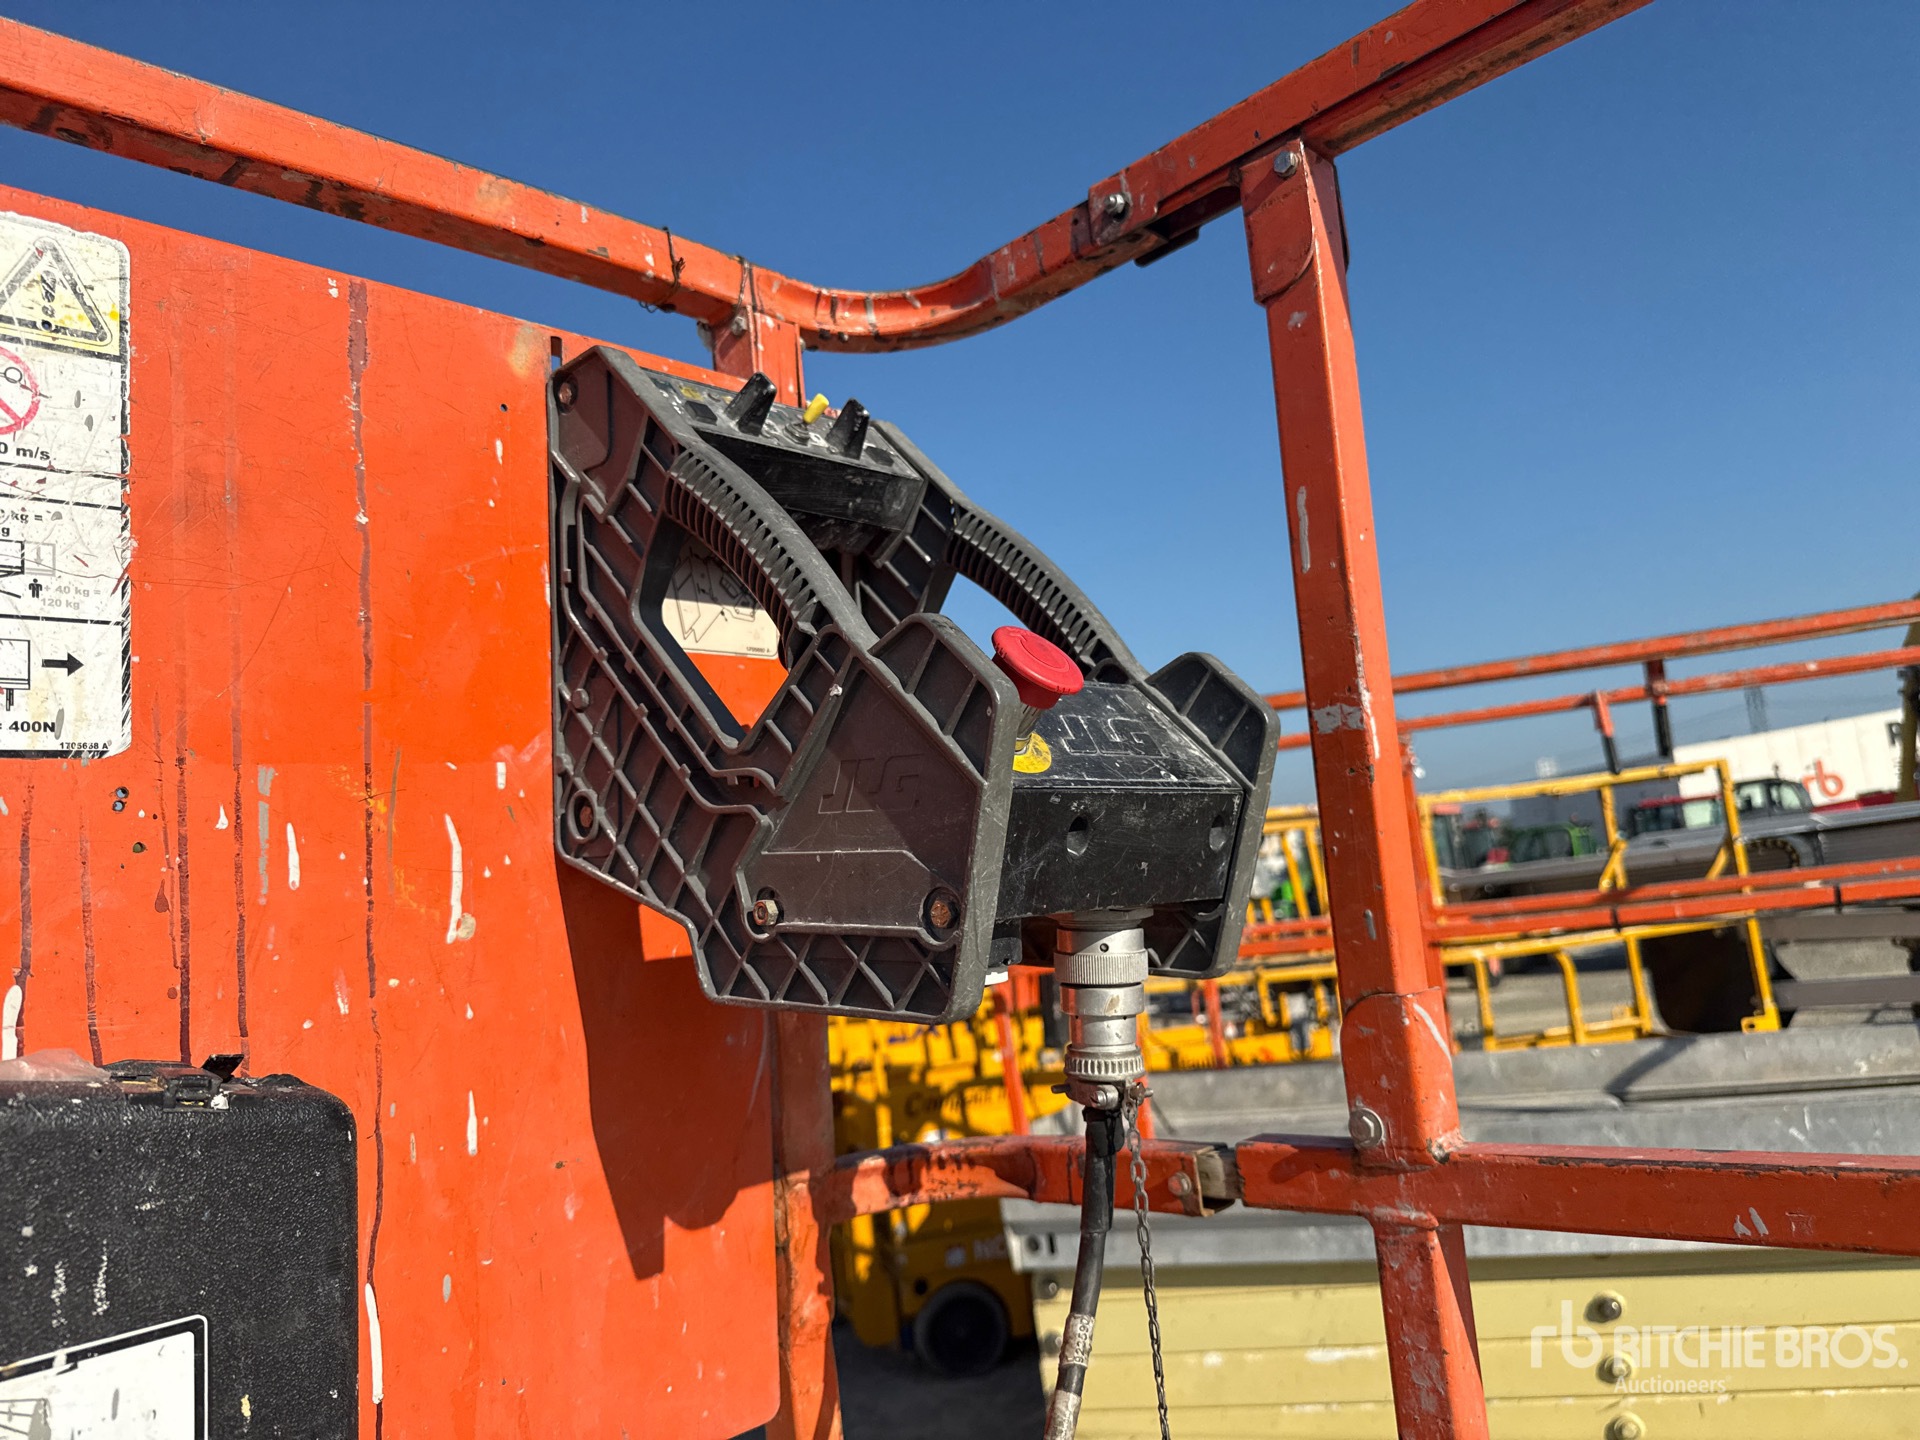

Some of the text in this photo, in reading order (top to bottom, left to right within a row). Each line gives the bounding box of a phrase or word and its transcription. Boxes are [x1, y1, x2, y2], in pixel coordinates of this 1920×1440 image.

[16, 447, 50, 460] m/s
[55, 585, 71, 594] 40
[75, 587, 90, 597] kg
[41, 598, 80, 610] 120 kg
[9, 720, 55, 732] 400N
[1060, 713, 1170, 757] JLG
[818, 753, 925, 814] JLG
